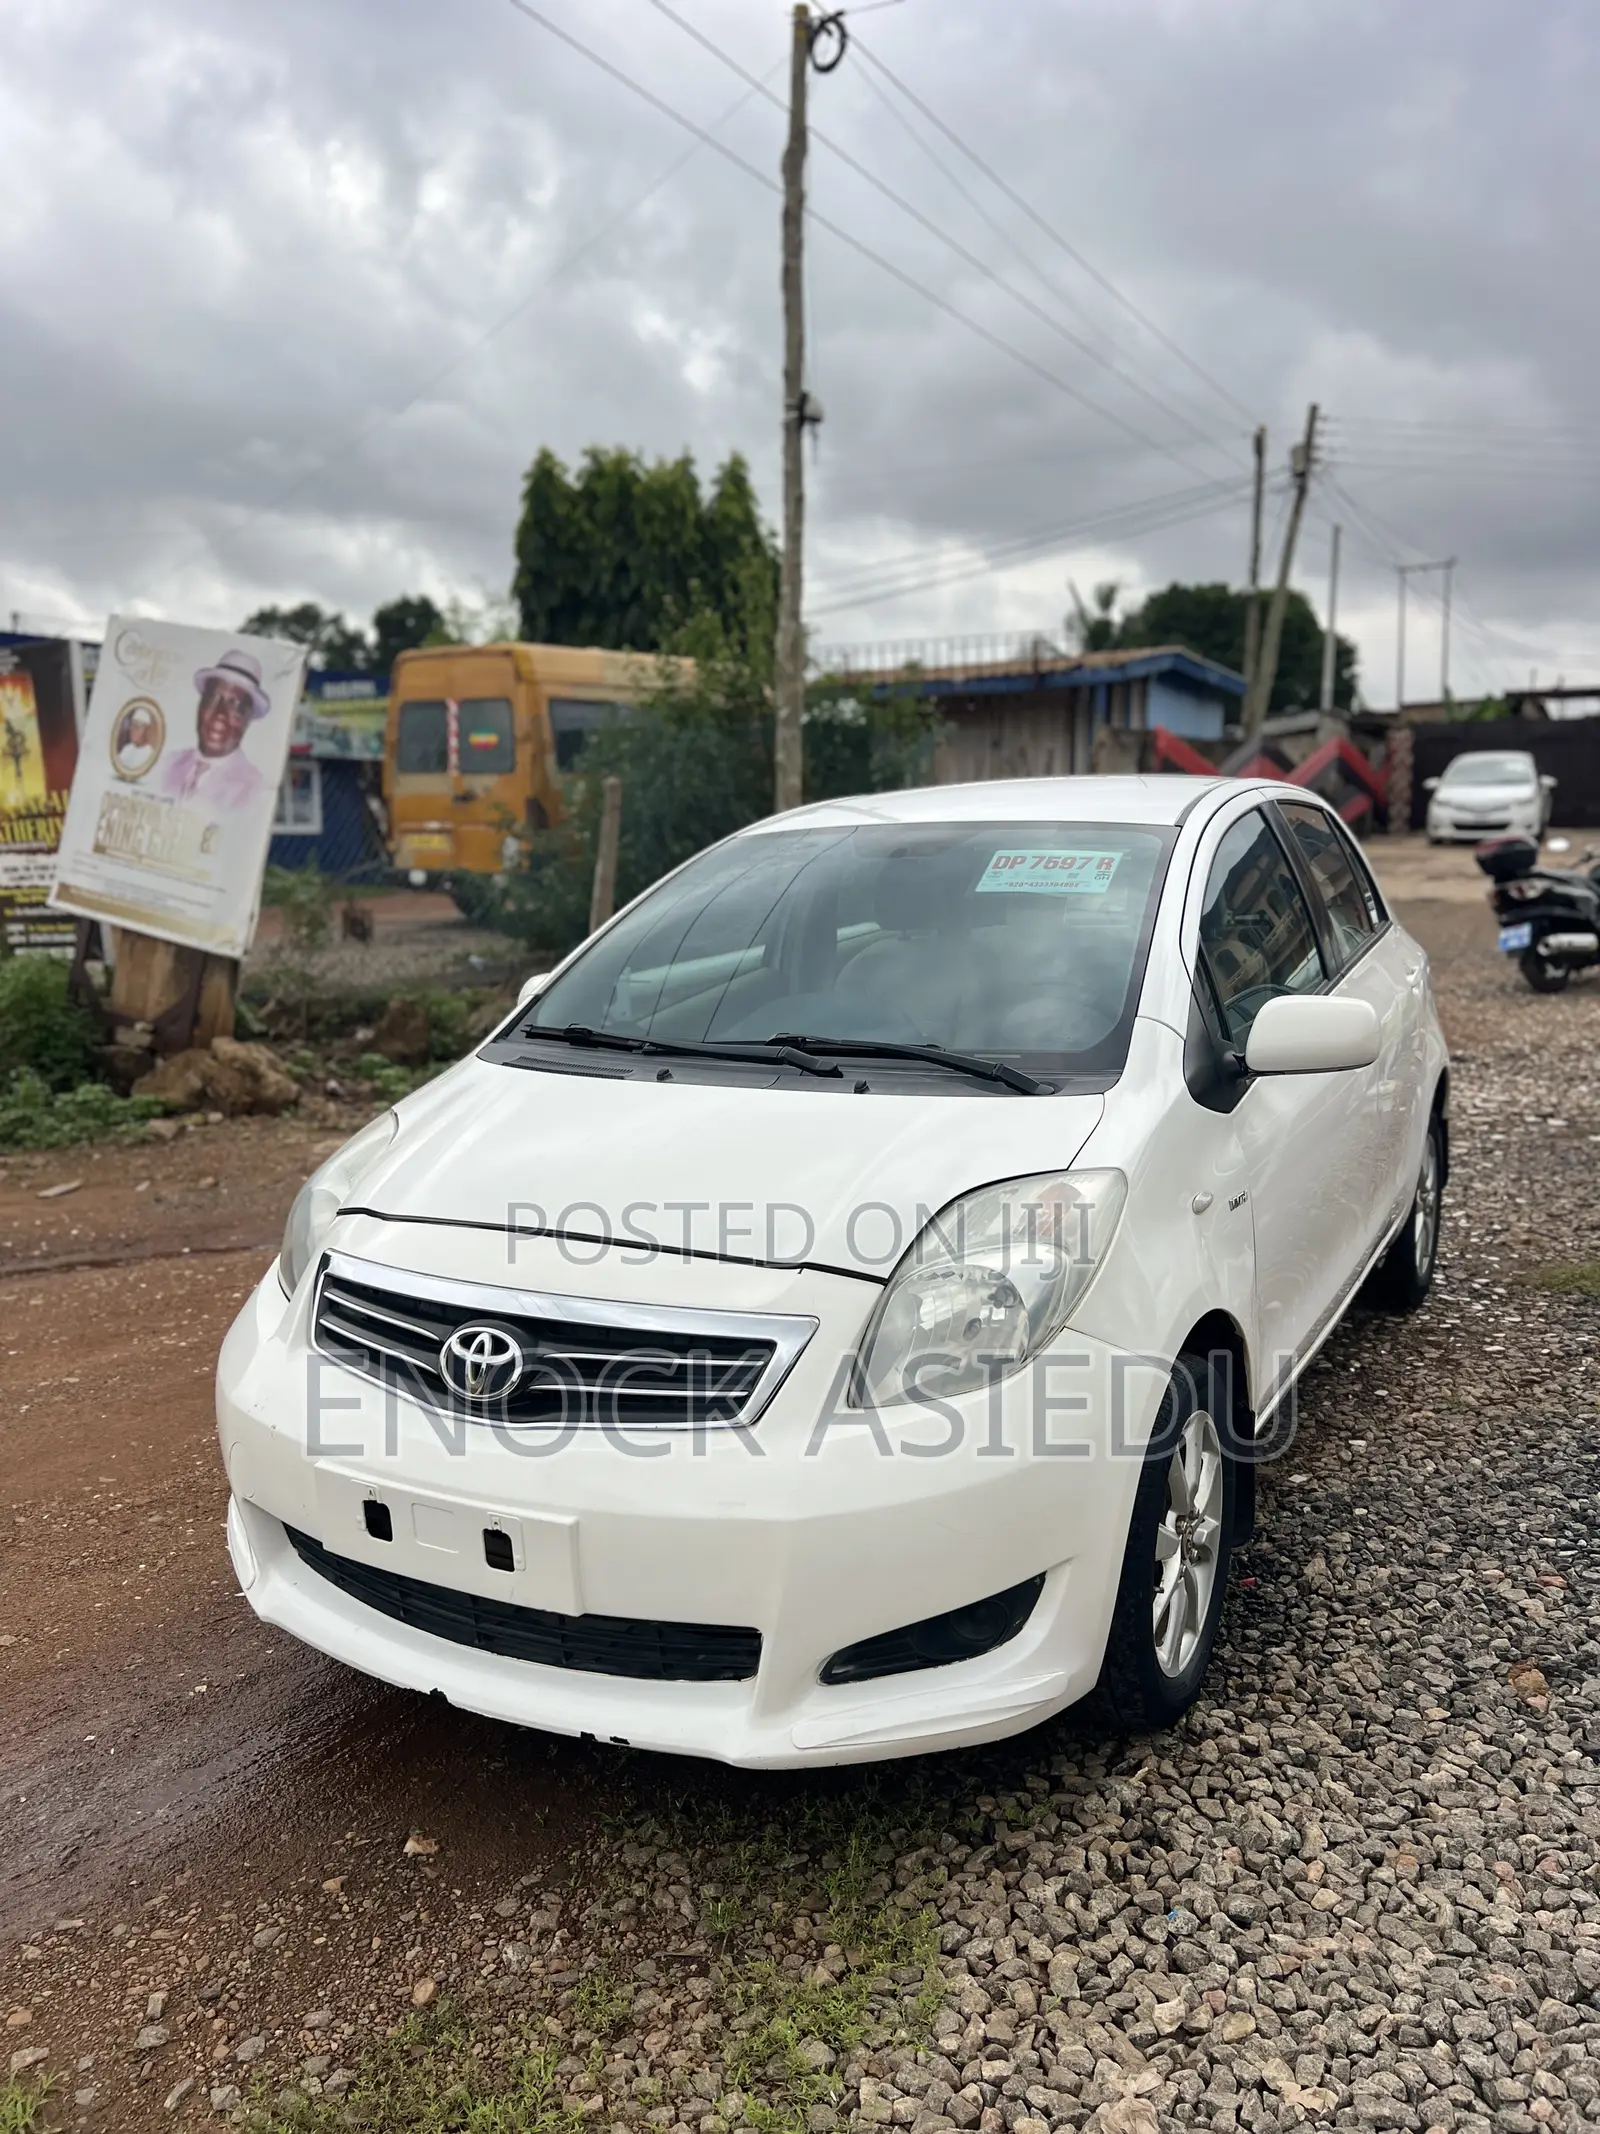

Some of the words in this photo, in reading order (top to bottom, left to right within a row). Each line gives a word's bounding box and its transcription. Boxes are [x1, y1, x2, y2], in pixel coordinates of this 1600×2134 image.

[992, 855, 1027, 870] DP
[1029, 855, 1094, 870] 7697
[1095, 856, 1115, 870] R
